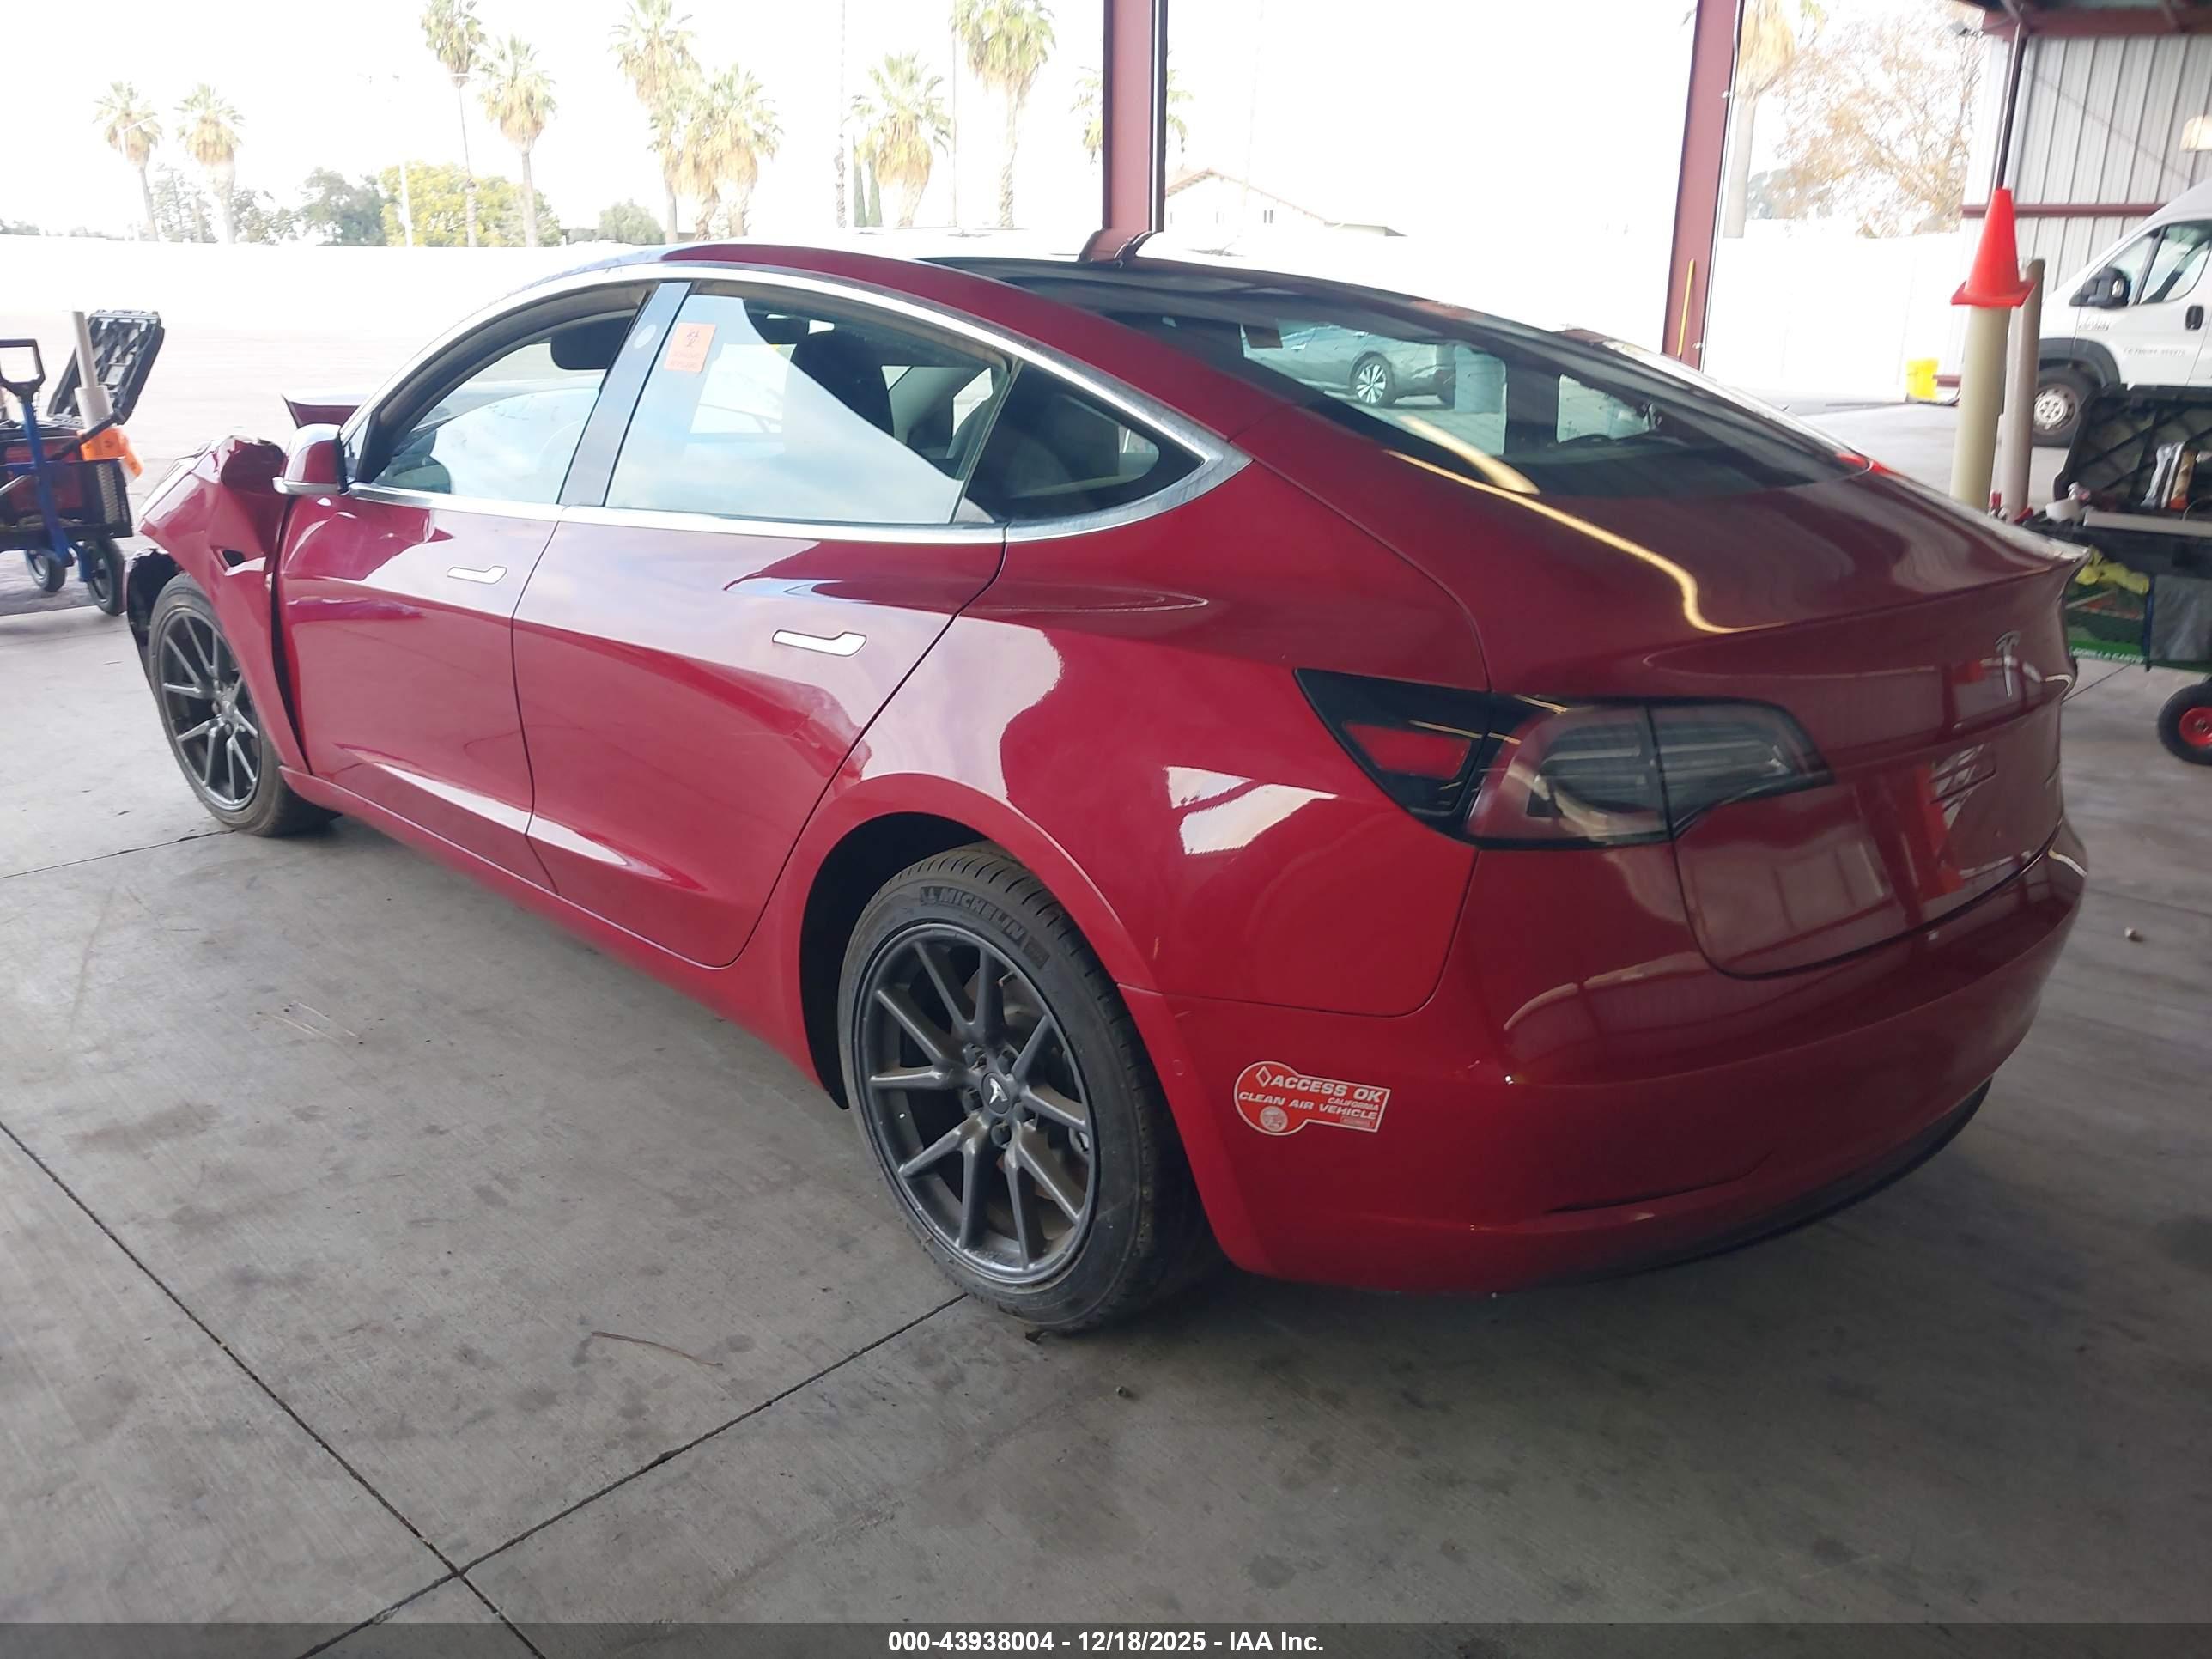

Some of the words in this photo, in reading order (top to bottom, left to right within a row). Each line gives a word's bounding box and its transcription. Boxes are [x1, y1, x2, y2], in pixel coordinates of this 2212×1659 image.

[939, 887, 1026, 940] MICHELIN
[1271, 1074, 1348, 1097] ACCESS
[1353, 1088, 1383, 1103] OK
[1238, 1091, 1285, 1106] CLEAN
[1288, 1099, 1314, 1110] AIR
[1318, 1103, 1378, 1119] VEHICLE
[1328, 1097, 1379, 1111] CALIFORNIA
